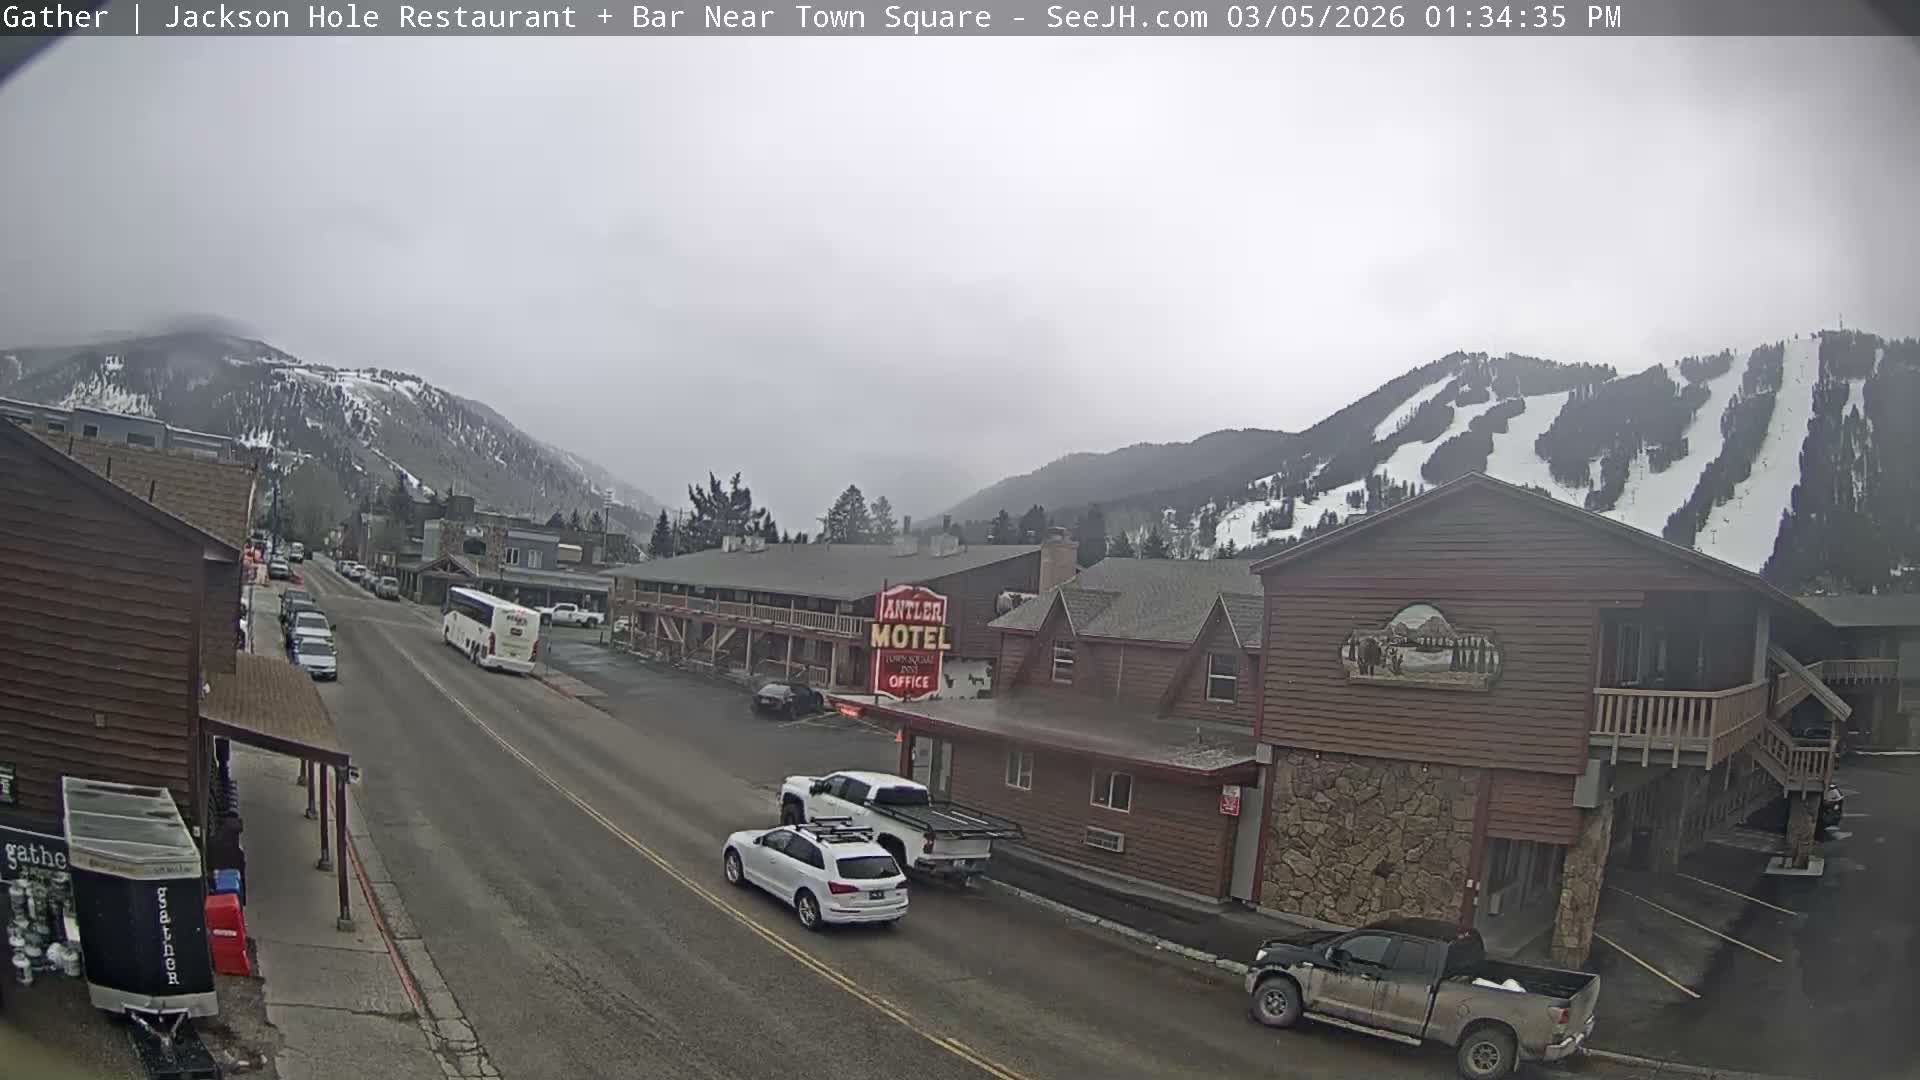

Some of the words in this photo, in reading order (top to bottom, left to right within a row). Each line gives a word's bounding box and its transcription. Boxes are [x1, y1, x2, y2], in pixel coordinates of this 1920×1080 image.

[884, 599, 942, 622] ANTLER
[871, 623, 952, 650] MOTEL
[888, 675, 930, 689] OFFICE
